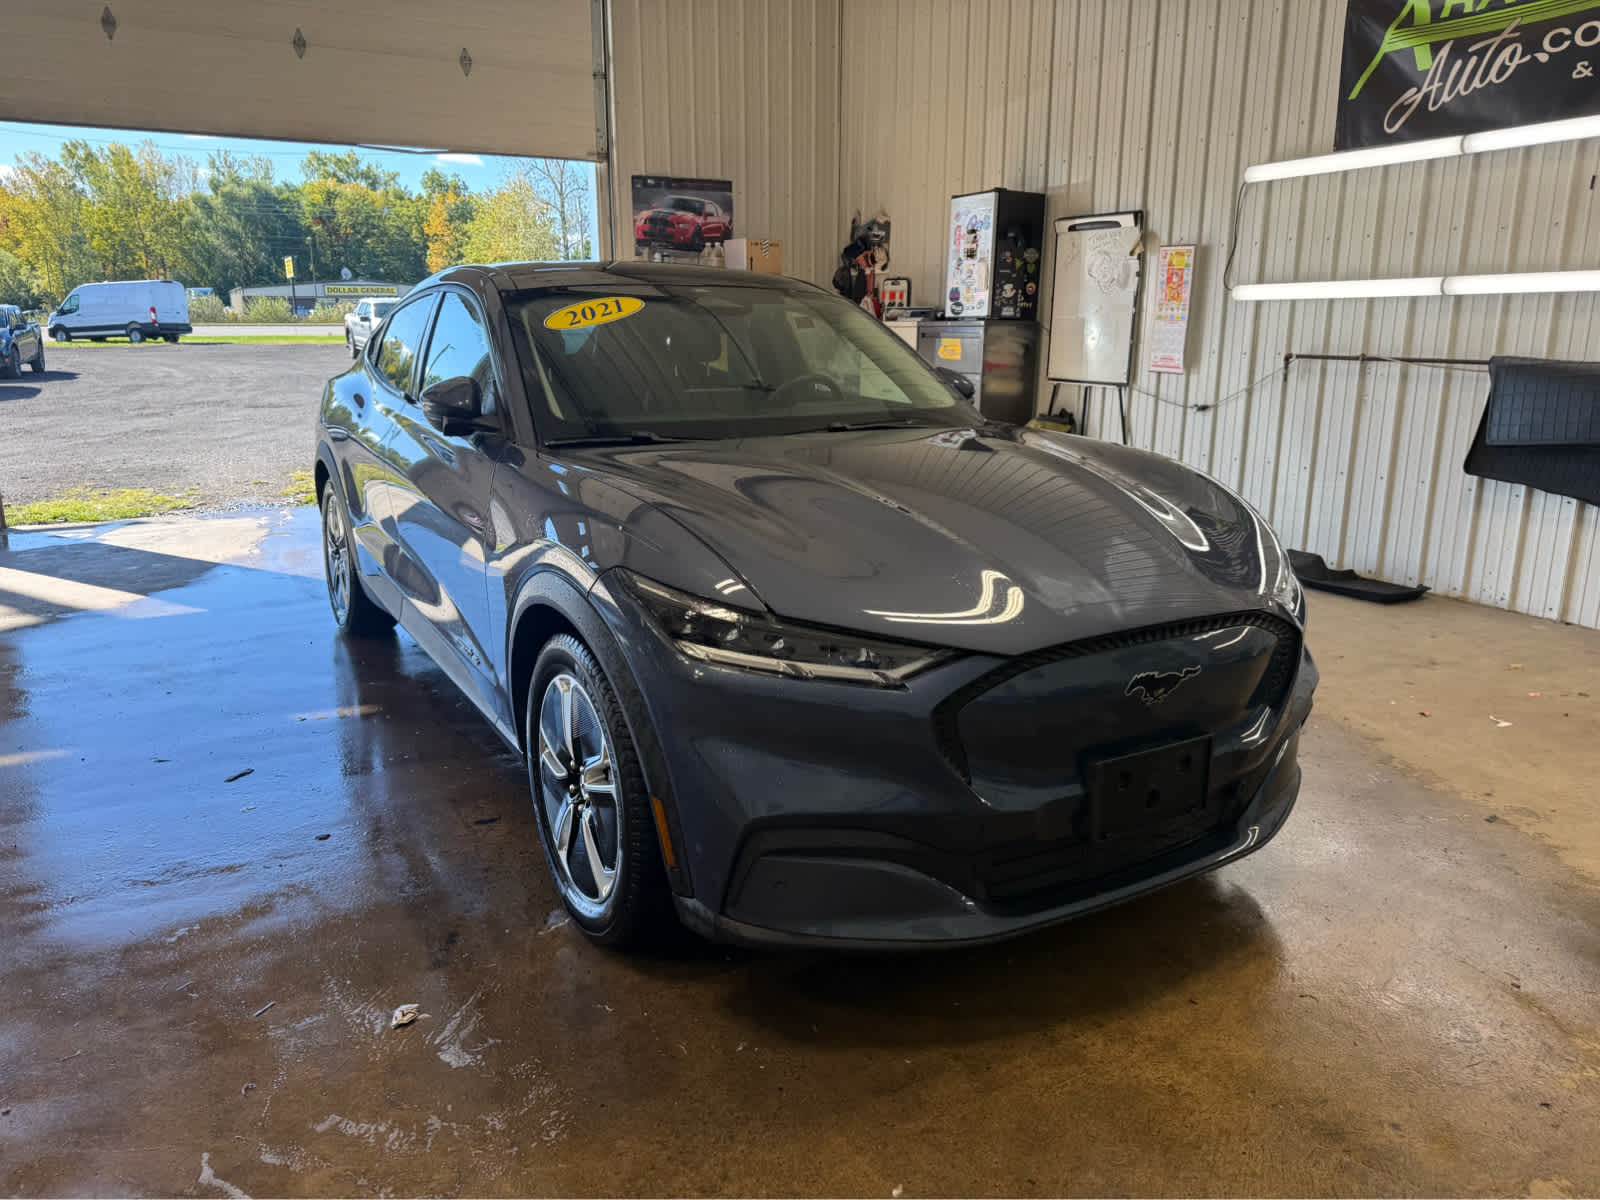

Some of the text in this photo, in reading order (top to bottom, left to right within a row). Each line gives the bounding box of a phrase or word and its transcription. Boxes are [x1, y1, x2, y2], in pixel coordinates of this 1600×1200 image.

[1572, 60, 1593, 79] &
[327, 287, 396, 295] DOLLAR GENERAL
[565, 300, 622, 325] 2021
